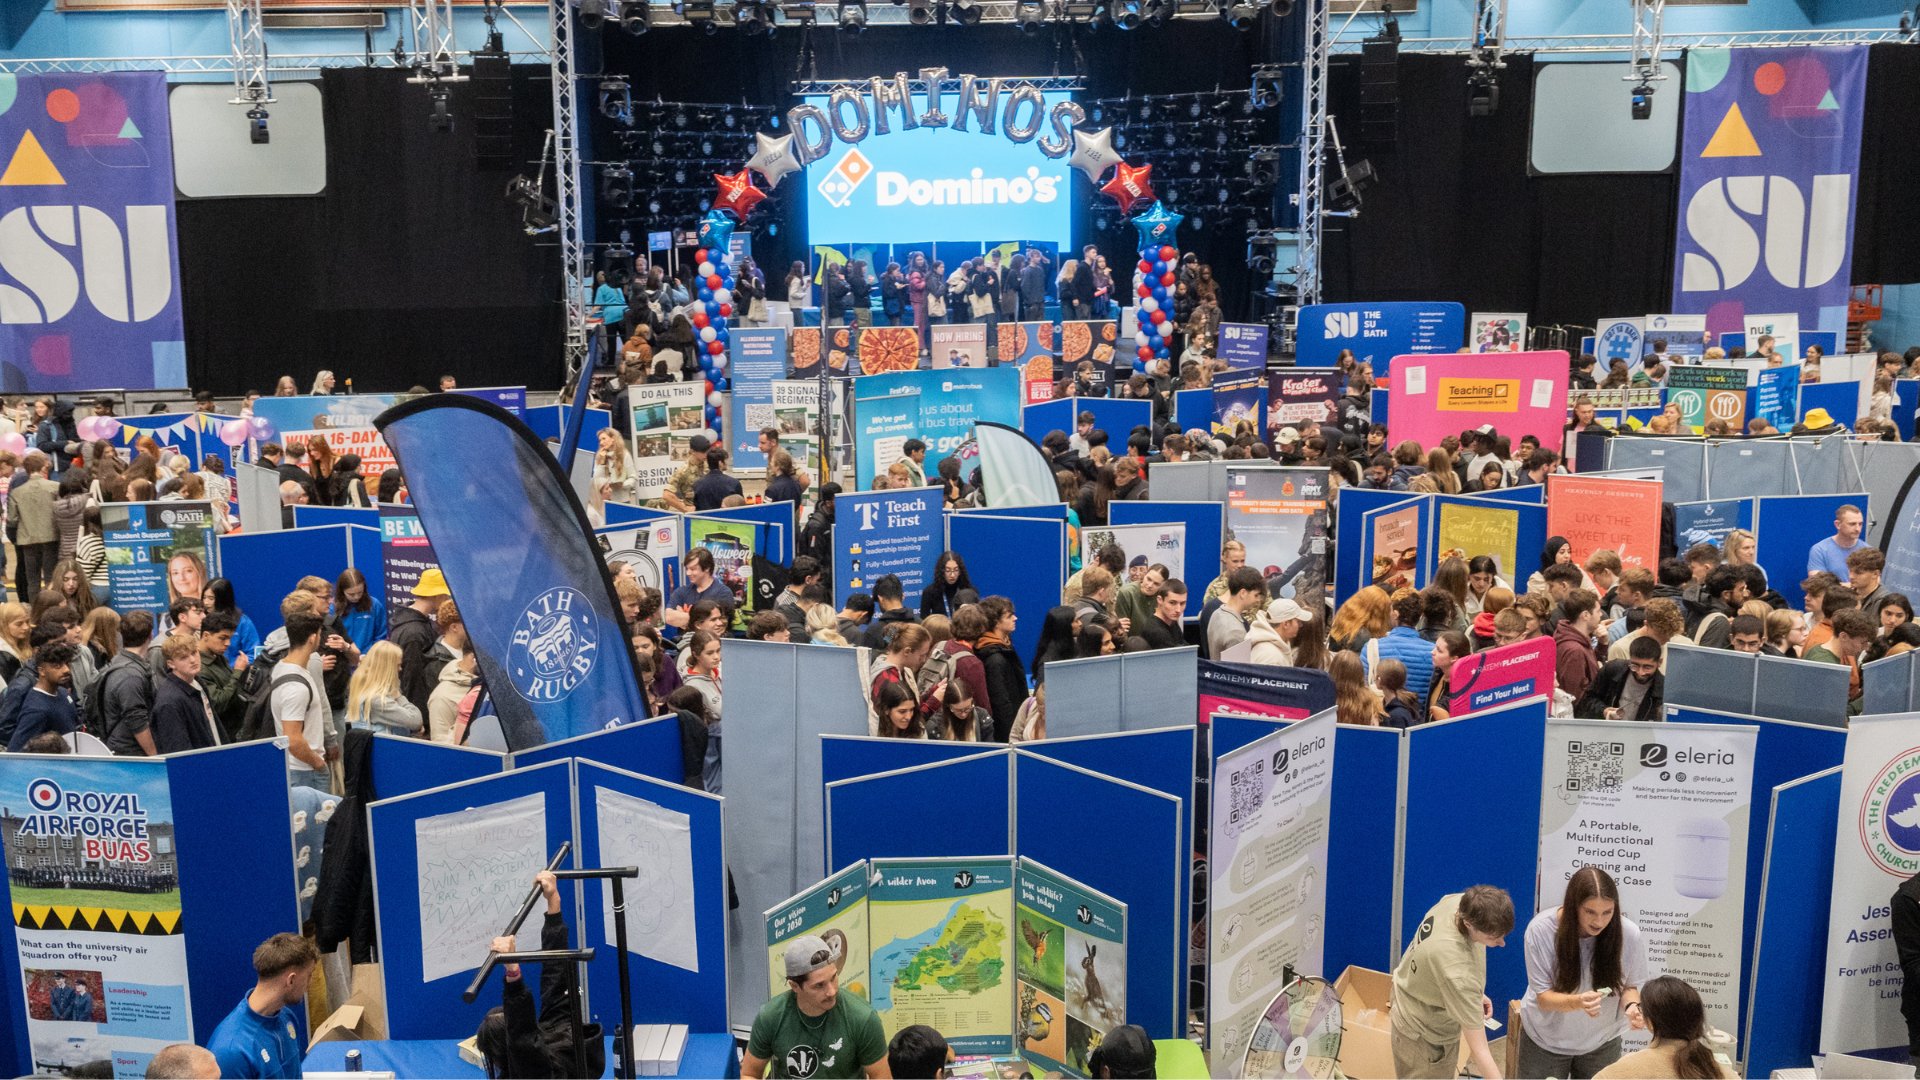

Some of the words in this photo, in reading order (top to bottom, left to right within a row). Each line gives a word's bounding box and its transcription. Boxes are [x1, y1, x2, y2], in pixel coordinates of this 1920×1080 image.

[787, 66, 1087, 166] DOMINOS
[876, 166, 1059, 206] Domino's
[1682, 174, 1850, 291] SU
[0, 205, 172, 325] SU
[1364, 311, 1382, 319] THE
[1324, 312, 1359, 339] SU
[1364, 320, 1376, 328] SU
[1750, 324, 1774, 335] nus
[933, 331, 953, 343] NOW
[955, 330, 984, 342] HIRING
[1364, 329, 1388, 338] BATH
[1282, 378, 1322, 390] Krater
[1705, 375, 1726, 383] work
[641, 390, 654, 399] DO
[656, 389, 671, 398] ALL
[674, 387, 693, 396] THIS
[776, 386, 786, 395] 39
[787, 386, 820, 395] SIGNAL
[1031, 390, 1053, 400] DEALS
[1449, 386, 1493, 396] Teaching
[925, 407, 938, 416] us
[940, 403, 974, 414] about
[871, 416, 893, 424] We've
[893, 414, 907, 423] got
[926, 416, 945, 427] bus
[330, 430, 378, 445] 16-DAY
[638, 469, 649, 479] 39
[1301, 485, 1322, 493] ARMY
[1565, 487, 1604, 495] HEAVENLY
[1605, 490, 1645, 498] DESSERTS
[885, 498, 926, 513] Teach
[176, 512, 204, 521] BATH
[887, 514, 920, 528] First
[1575, 512, 1601, 524] LIVE
[1606, 515, 1632, 526] THE
[384, 520, 405, 536] BE
[112, 532, 140, 540] Student
[141, 531, 171, 540] Support
[890, 535, 917, 544] teaching
[1450, 534, 1479, 544] RIGHT
[1482, 537, 1507, 547] HERE
[1566, 529, 1608, 542] SWEET
[1610, 534, 1633, 545] LIFE
[865, 546, 897, 555] leadership
[897, 544, 922, 552] training
[390, 559, 426, 570] Wellbeing
[865, 560, 904, 569] Fully-funded
[904, 556, 921, 564] PGCE
[400, 572, 418, 580] Well
[392, 584, 402, 592] Six
[513, 591, 574, 646] BATH
[527, 635, 596, 699] RUGBY
[1477, 652, 1540, 674] RATEMYPLACEMENT
[1212, 671, 1309, 691] RATEMYPLACEMENT
[1475, 693, 1493, 705] Find
[1494, 689, 1511, 700] Your
[1512, 683, 1530, 695] Next
[1291, 736, 1326, 761] eleria
[1674, 747, 1735, 766] eleria
[1692, 775, 1735, 784] @eleria_uk
[1632, 785, 1655, 793] Making
[1656, 787, 1681, 795] periods
[65, 791, 147, 816] ROYAL
[1868, 800, 1882, 826] THE
[20, 814, 67, 836] AIR
[68, 815, 148, 839] FORCE
[1579, 819, 1587, 829] A
[1590, 820, 1643, 832] Portable,
[1566, 831, 1654, 847] Multifunctional
[85, 839, 152, 863] BUAS
[1577, 846, 1615, 857] Period
[1617, 848, 1641, 860] Cup
[1876, 843, 1919, 870] CHURCH
[1624, 863, 1646, 873] and
[431, 872, 460, 891] WIN
[467, 870, 478, 881] A
[483, 858, 532, 879] PROTEIN
[887, 877, 913, 886] wilder
[916, 877, 937, 886] Avon
[1623, 876, 1652, 887] Case
[435, 890, 460, 906] BAR
[471, 885, 487, 897] OR
[492, 878, 529, 895] BOTTLE
[1021, 877, 1035, 890] Love
[1036, 885, 1064, 903] wildlife?
[1022, 889, 1035, 901] Join
[1036, 895, 1055, 913] today
[774, 917, 787, 929] Our
[788, 905, 807, 922] vision
[1093, 914, 1105, 923] Avon
[1639, 909, 1674, 919] Designed
[775, 928, 786, 940] for
[786, 918, 803, 933] 2030
[1639, 918, 1691, 928] manufactured
[1639, 926, 1663, 934] United
[1664, 927, 1697, 936] Kingdom
[20, 938, 43, 949] What
[67, 941, 82, 950] the
[85, 943, 133, 954] university
[135, 946, 148, 954] air
[1648, 939, 1679, 947] Suitable
[21, 951, 65, 960] squadron
[68, 952, 92, 961] offer
[94, 954, 118, 963] you?
[1648, 947, 1672, 955] Period
[1673, 949, 1689, 957] Cup
[1690, 950, 1716, 959] shapes
[1660, 967, 1681, 975] Made
[1682, 968, 1700, 976] from
[1839, 967, 1858, 977] For
[1860, 963, 1882, 975] with
[1868, 978, 1882, 987] be
[108, 987, 148, 997] Leadership
[1624, 1039, 1648, 1047] period
[116, 1057, 138, 1066] Sport
